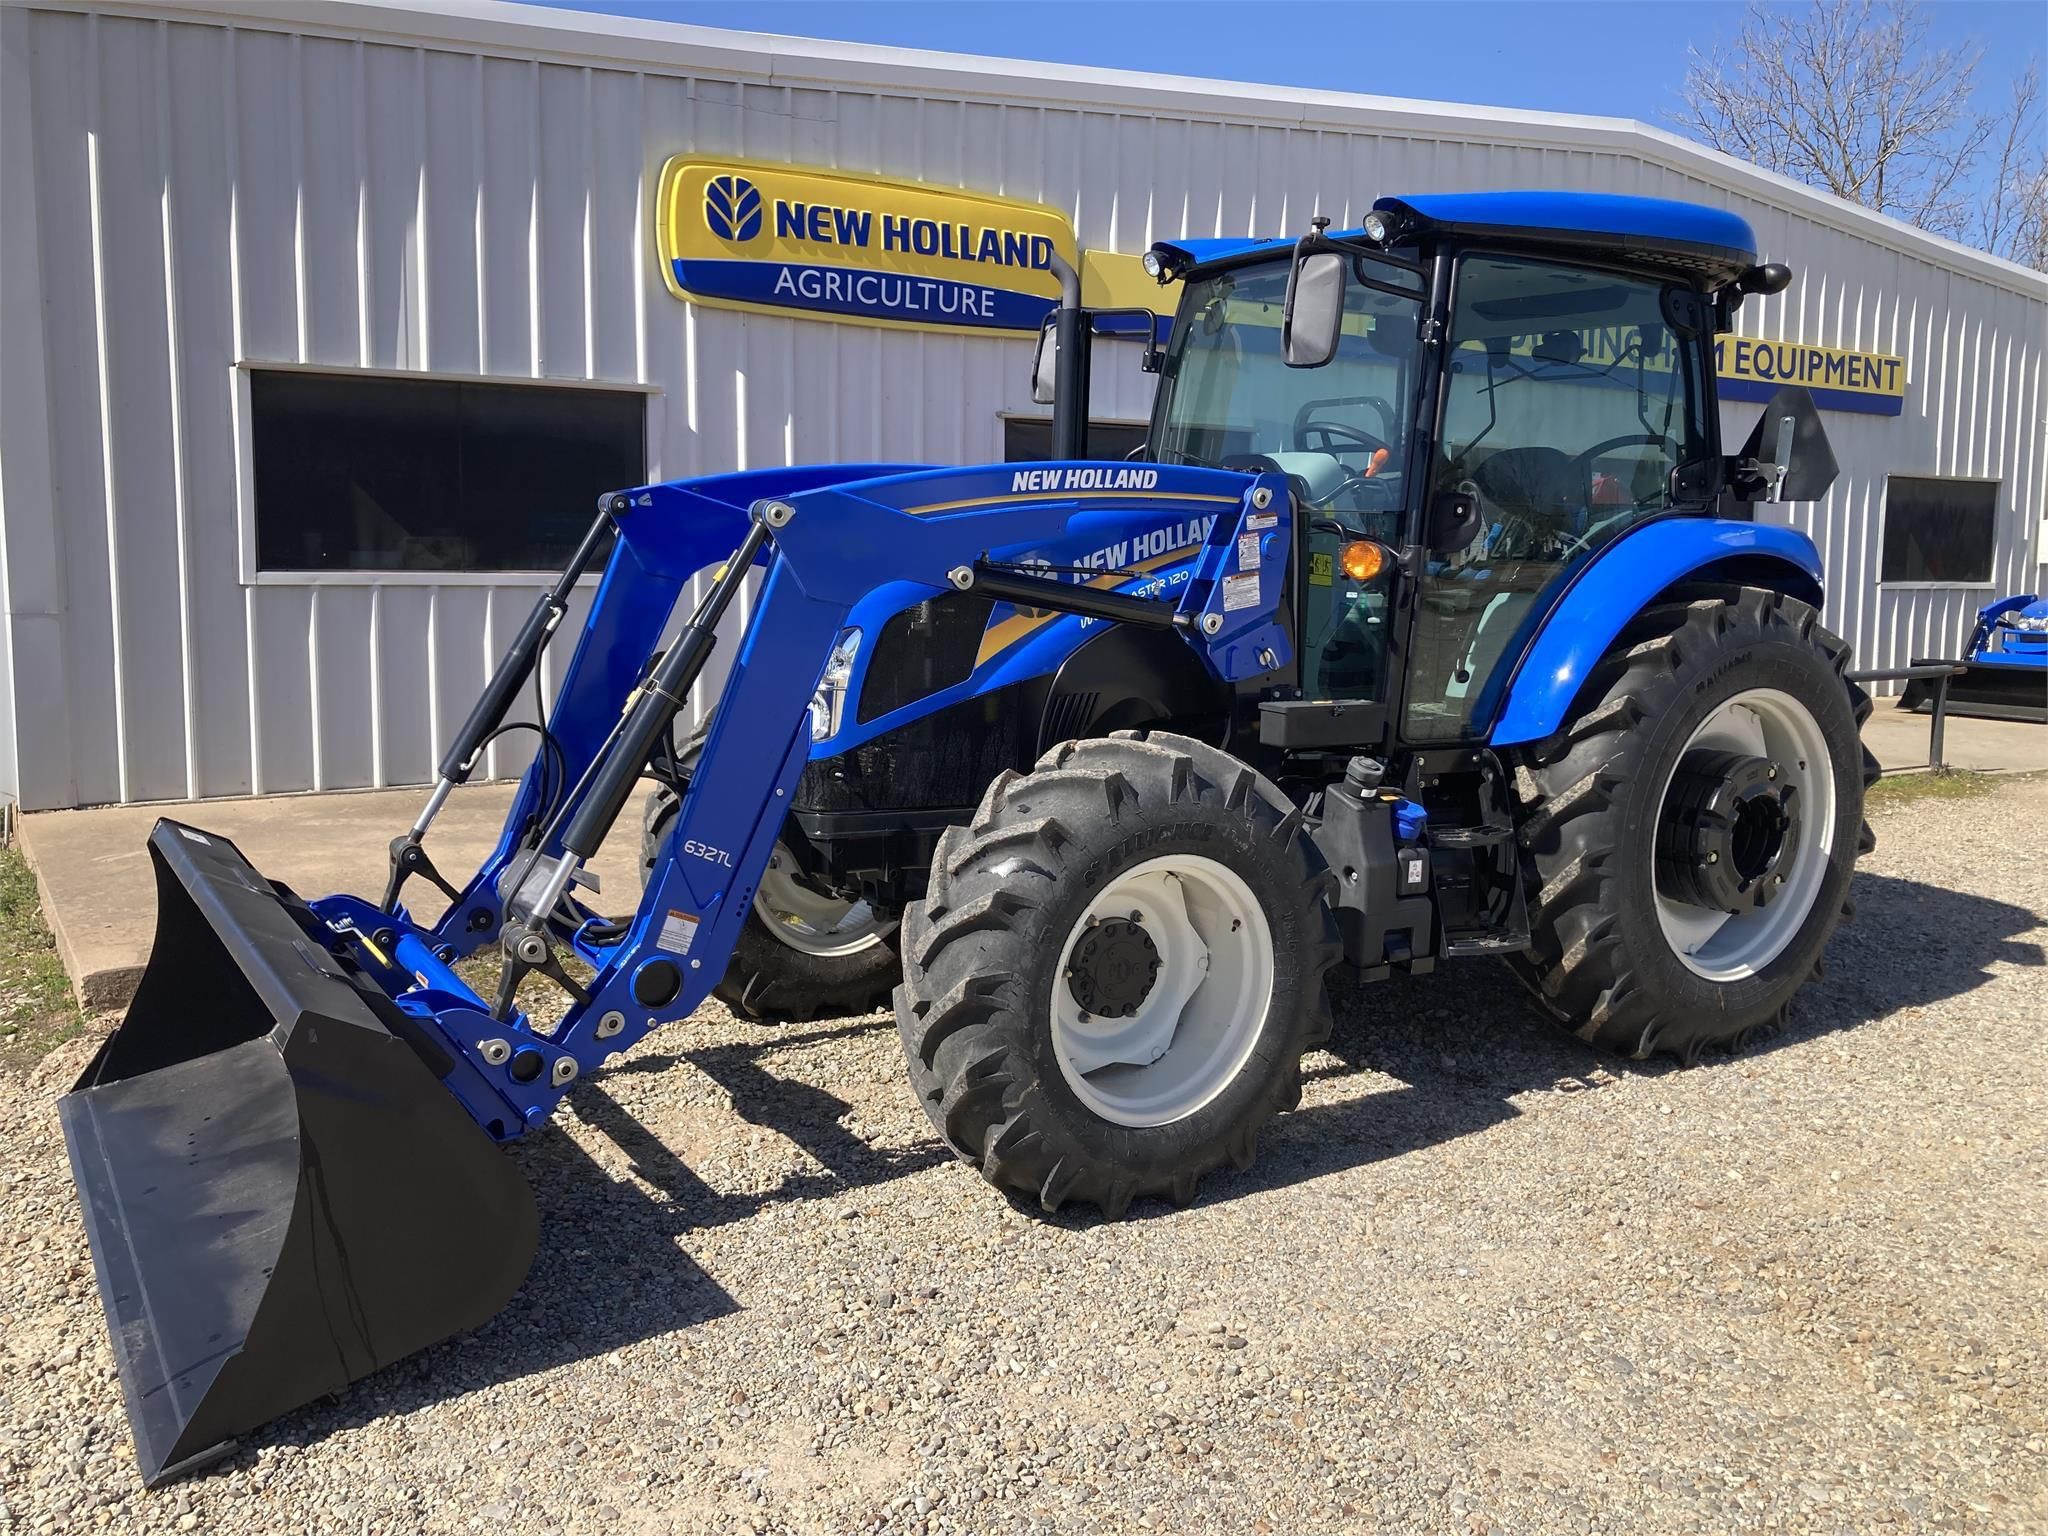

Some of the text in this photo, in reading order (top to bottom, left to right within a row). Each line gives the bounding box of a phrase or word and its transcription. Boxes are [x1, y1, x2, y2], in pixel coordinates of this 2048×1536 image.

[775, 200, 1054, 270] NEW HOLLAND
[774, 267, 996, 318] AGRICULTURE
[1735, 340, 1901, 390] EQUIPMENT
[1012, 469, 1158, 491] NEW HOLLAND
[1073, 541, 1127, 584] NEW
[1133, 514, 1217, 561] HOLLAN
[1168, 570, 1189, 585] 120
[684, 839, 733, 868] 632TL
